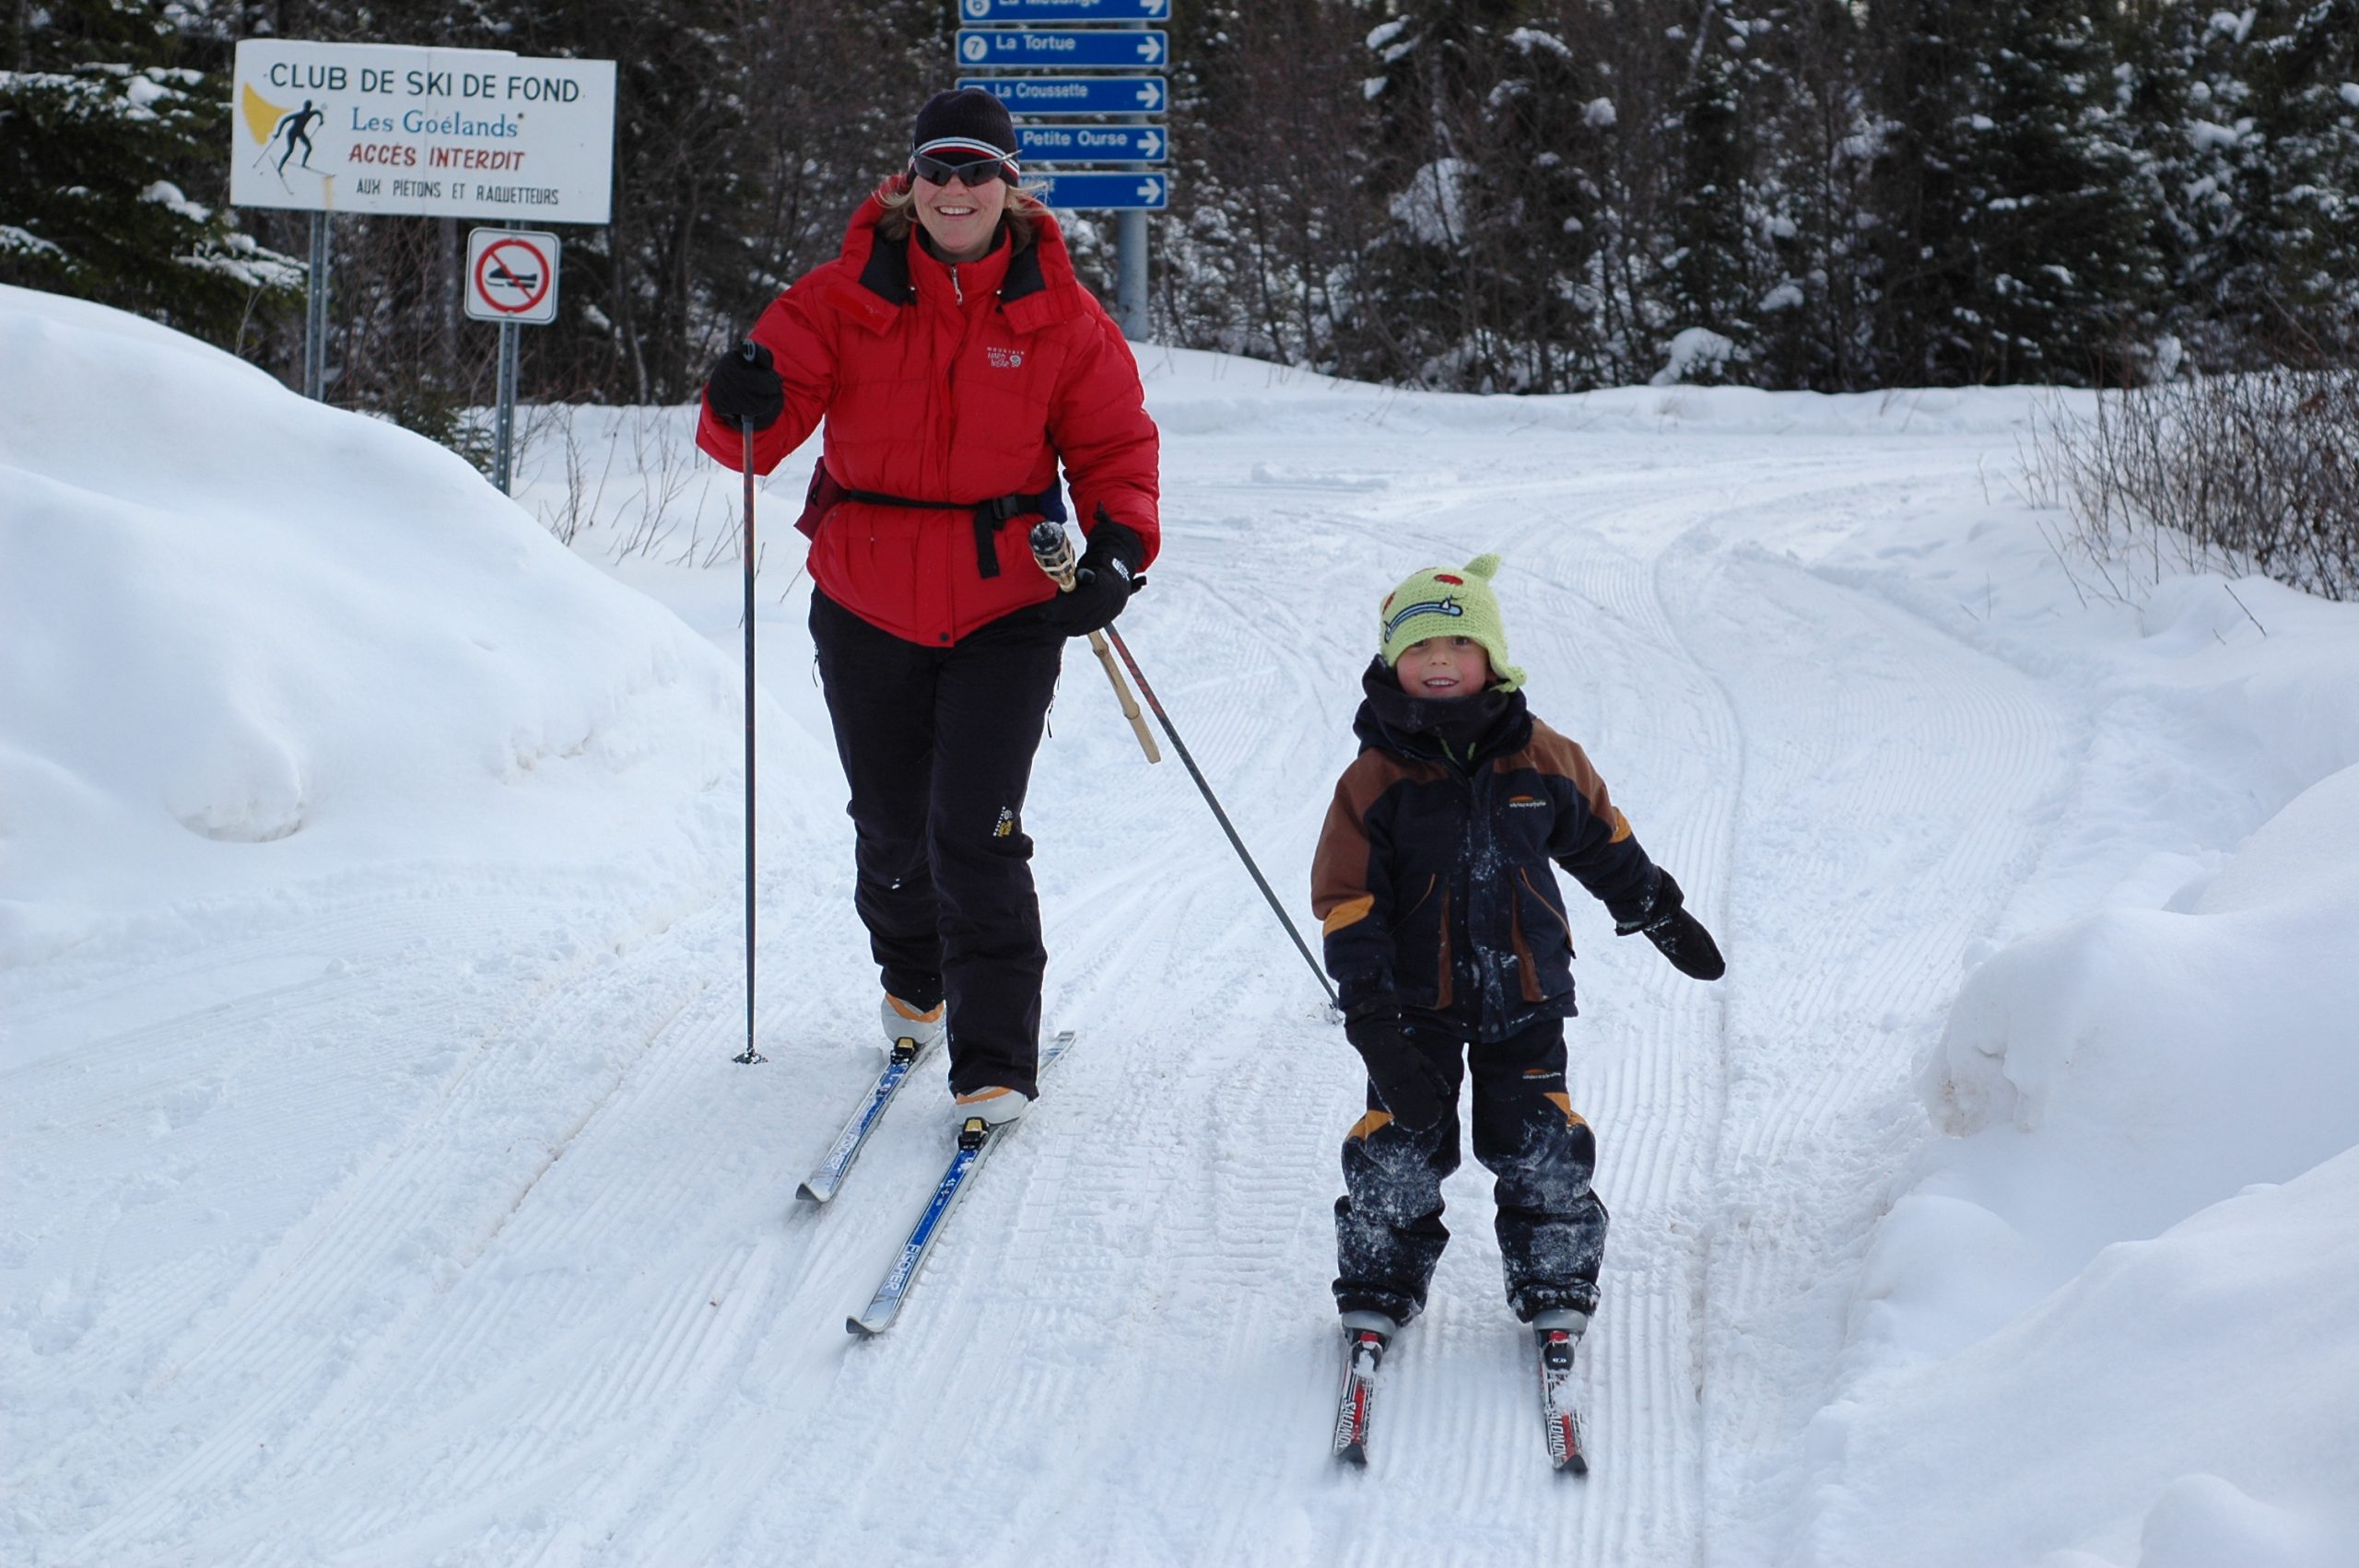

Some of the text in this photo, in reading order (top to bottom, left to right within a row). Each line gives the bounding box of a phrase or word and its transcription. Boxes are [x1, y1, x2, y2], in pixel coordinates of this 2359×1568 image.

[995, 35, 1016, 50] La
[1023, 35, 1076, 50] Tortue
[270, 63, 580, 102] CLUB DE SKI DE FOND
[995, 83, 1012, 98] La
[351, 107, 394, 132] Les
[1022, 130, 1128, 146] Petite Ourse
[428, 147, 525, 171] INTERDIT
[356, 178, 381, 194] AUX
[452, 183, 465, 199] ET
[476, 185, 559, 205] RAQUETTEURS
[829, 1132, 858, 1171] FISCHER
[885, 1244, 921, 1292] FISCHER
